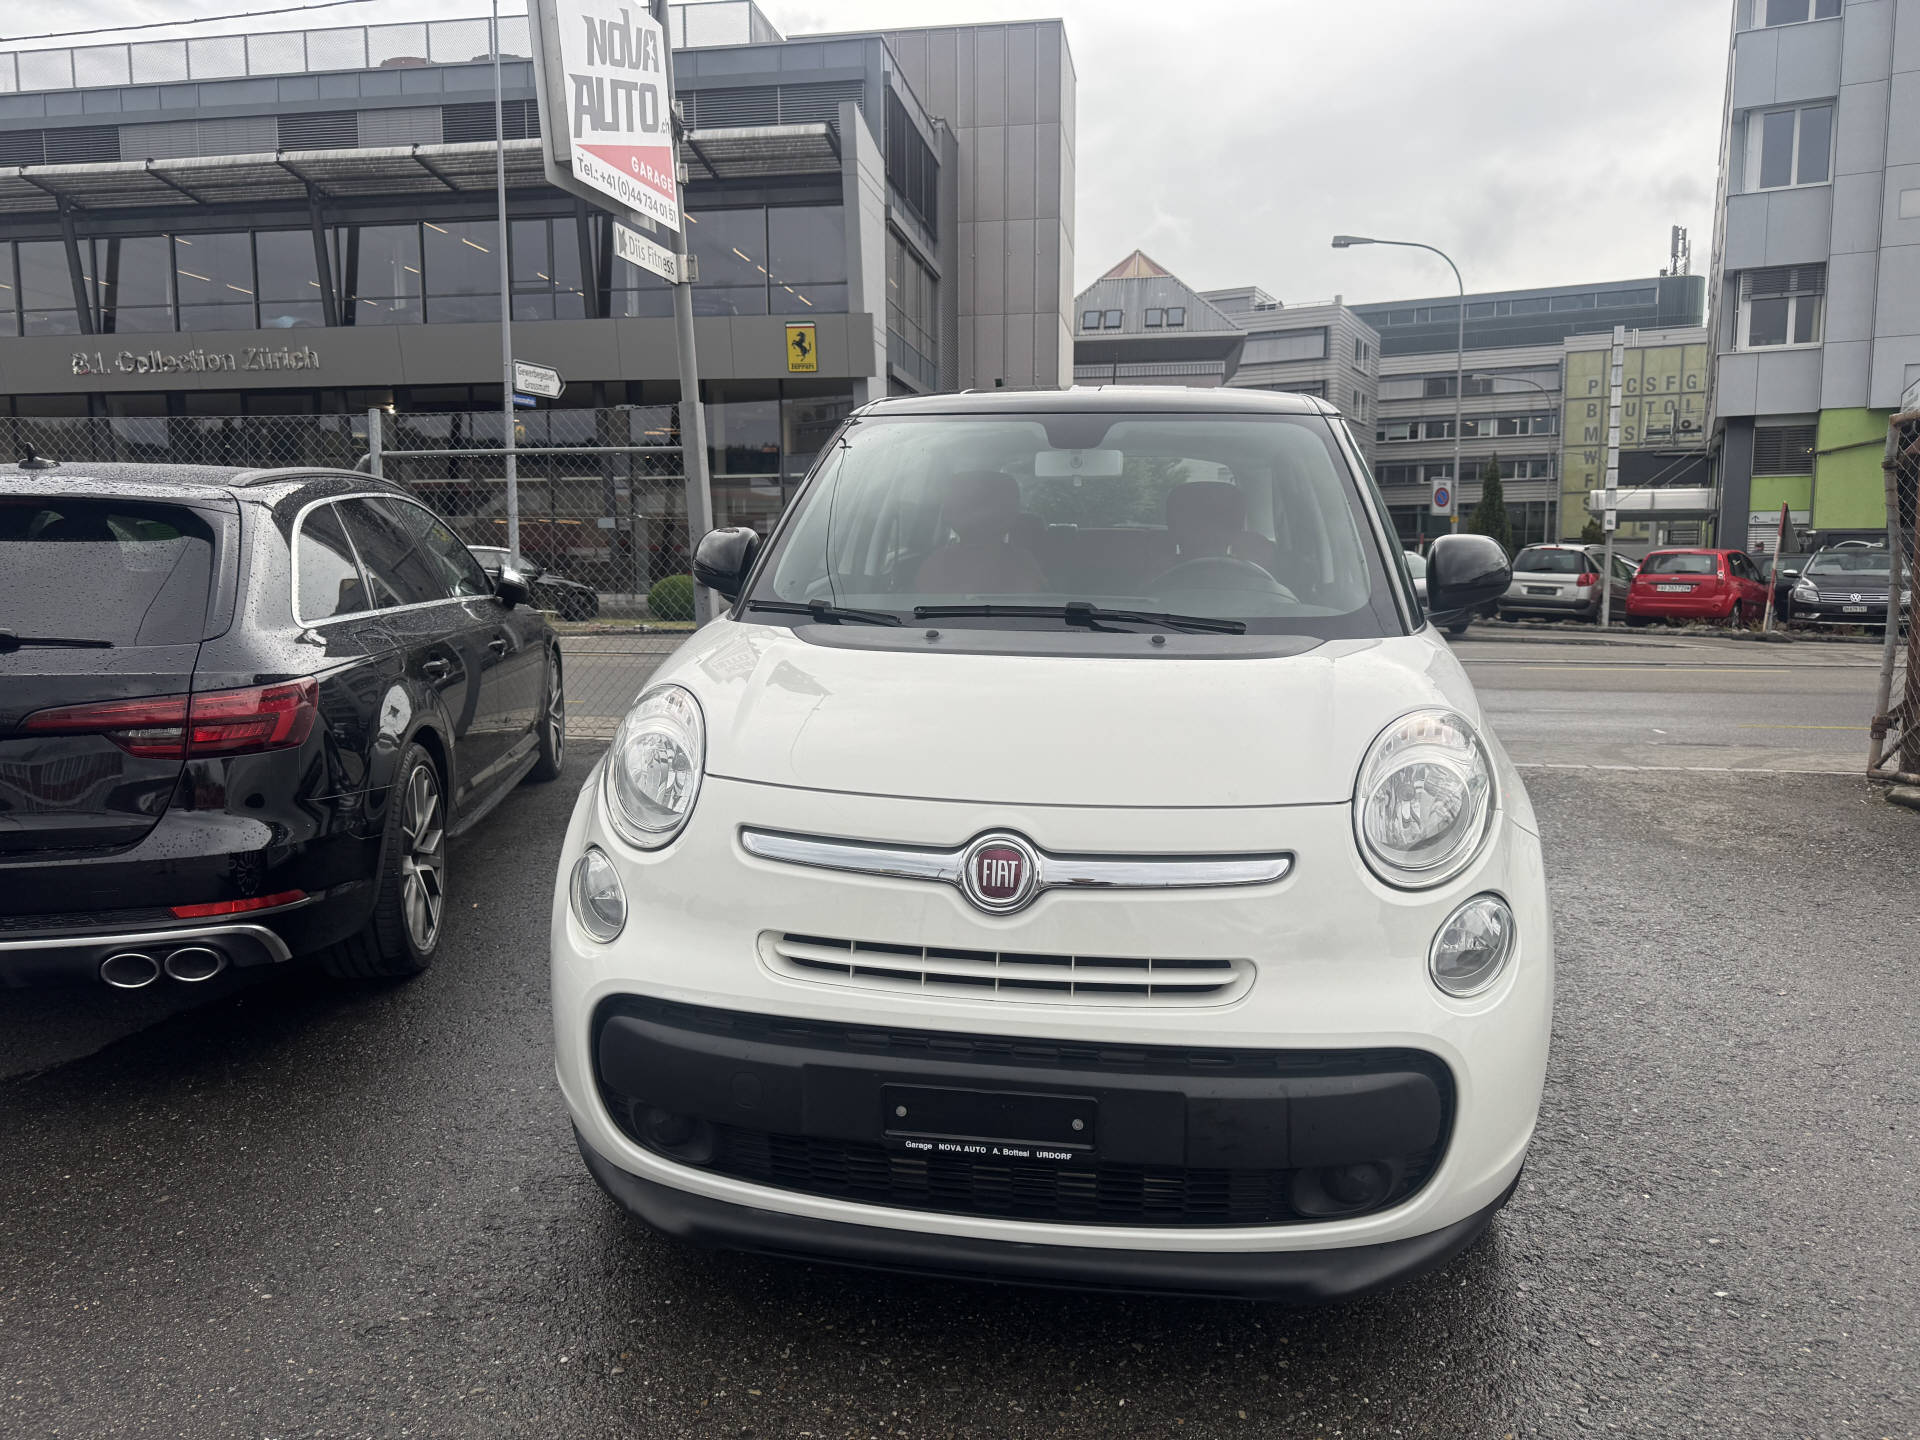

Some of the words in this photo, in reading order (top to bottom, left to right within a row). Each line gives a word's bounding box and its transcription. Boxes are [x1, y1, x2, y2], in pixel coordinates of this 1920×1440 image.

[581, 8, 660, 73] NOVA
[568, 73, 660, 138] AUTO
[577, 155, 599, 181] Tel.:
[600, 172, 616, 190] +41
[631, 156, 673, 193] GARAGE
[629, 235, 646, 261] Diis
[648, 246, 675, 275] Fitness
[116, 350, 236, 373] Collection
[242, 346, 319, 371] Zürich
[982, 859, 1019, 888] FIAT
[905, 1140, 933, 1151] Garage
[938, 1143, 962, 1152] NOVA
[963, 1145, 987, 1154] AUTO
[992, 1147, 1001, 1155] A.
[1036, 1151, 1073, 1161] URDORF
